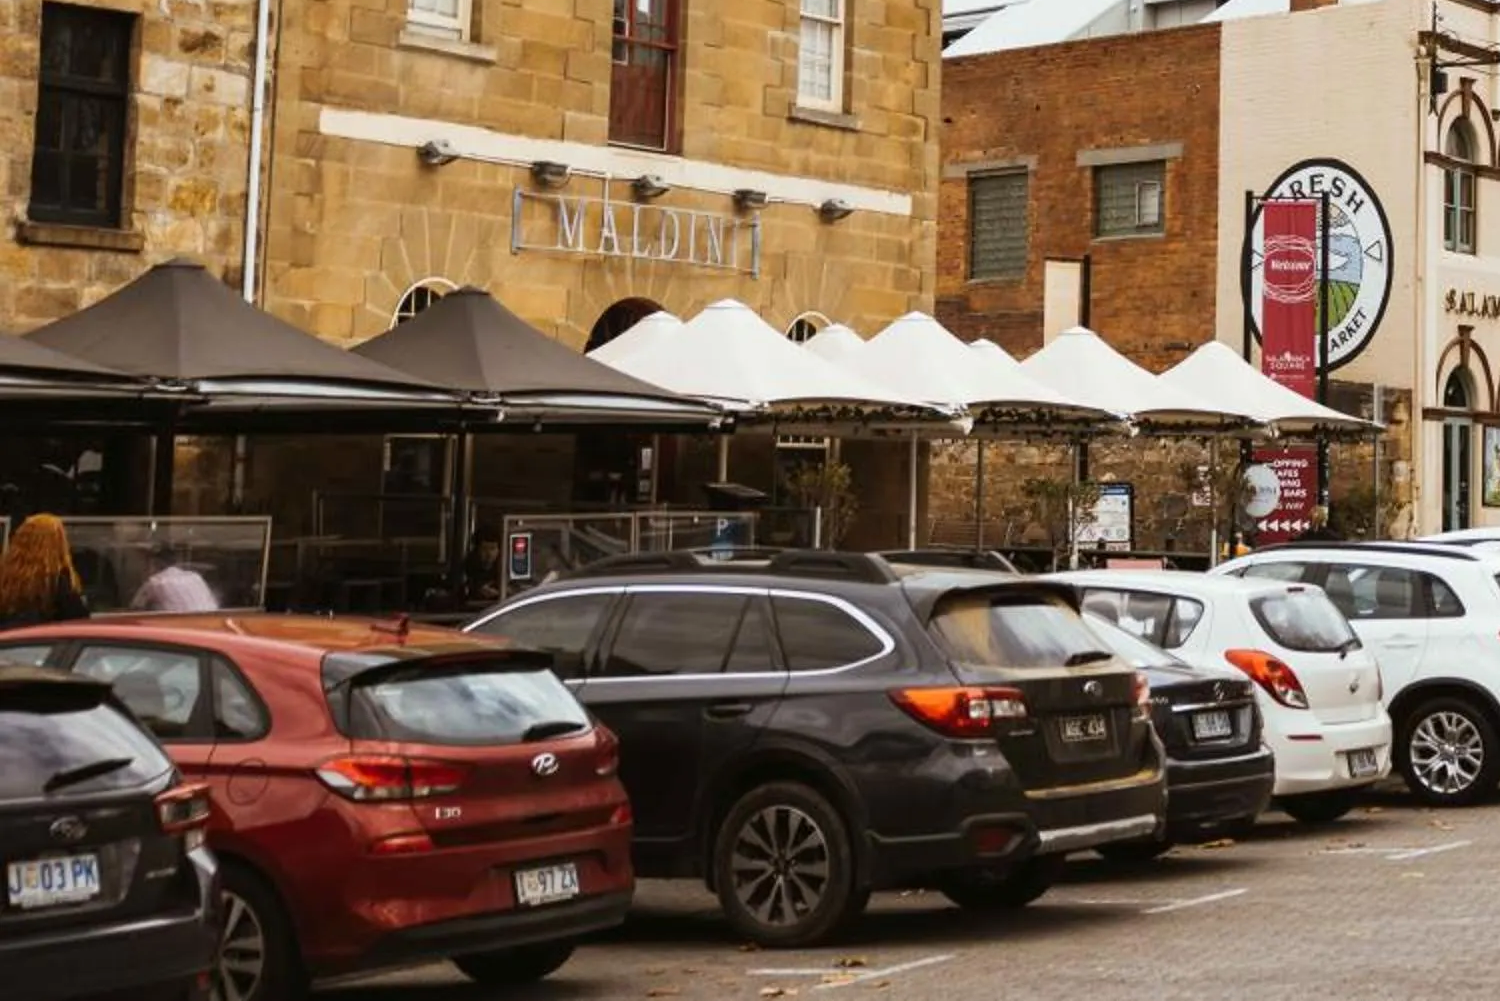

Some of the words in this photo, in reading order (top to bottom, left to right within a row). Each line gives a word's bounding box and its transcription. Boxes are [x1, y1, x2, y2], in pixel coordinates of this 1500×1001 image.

[1275, 173, 1364, 214] RESH
[556, 195, 738, 267] MALDINI
[1330, 307, 1368, 351] ARKET
